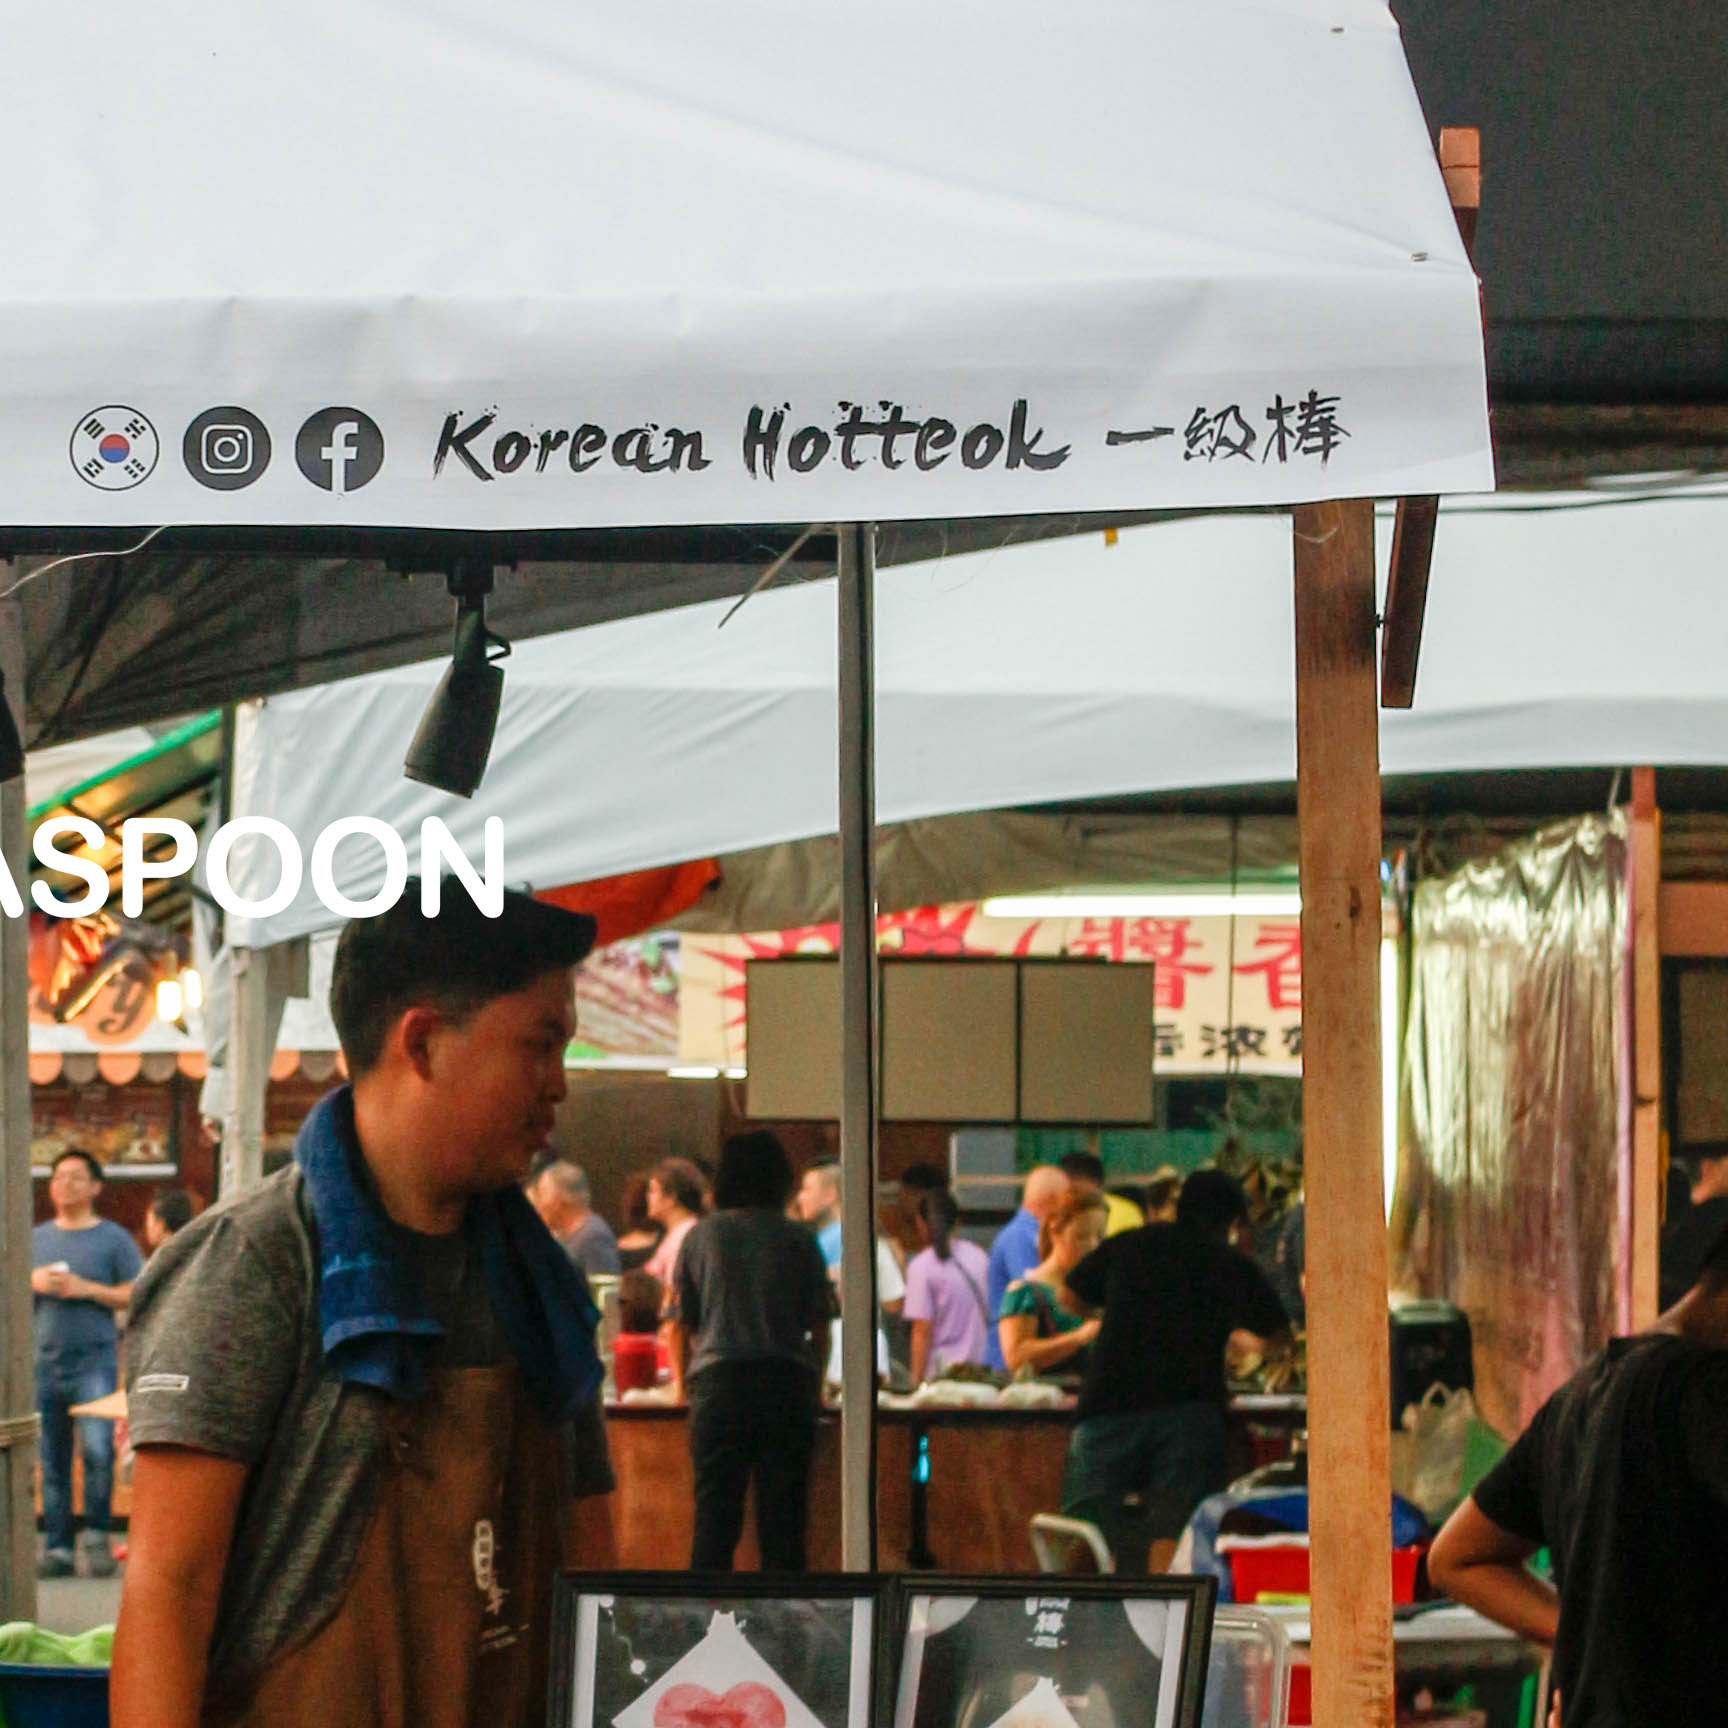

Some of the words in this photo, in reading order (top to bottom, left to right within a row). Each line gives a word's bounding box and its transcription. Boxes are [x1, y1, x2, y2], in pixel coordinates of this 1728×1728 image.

[432, 407, 712, 483] Korean
[742, 399, 1072, 485] Hotteok
[1104, 389, 1355, 466] 一級棒
